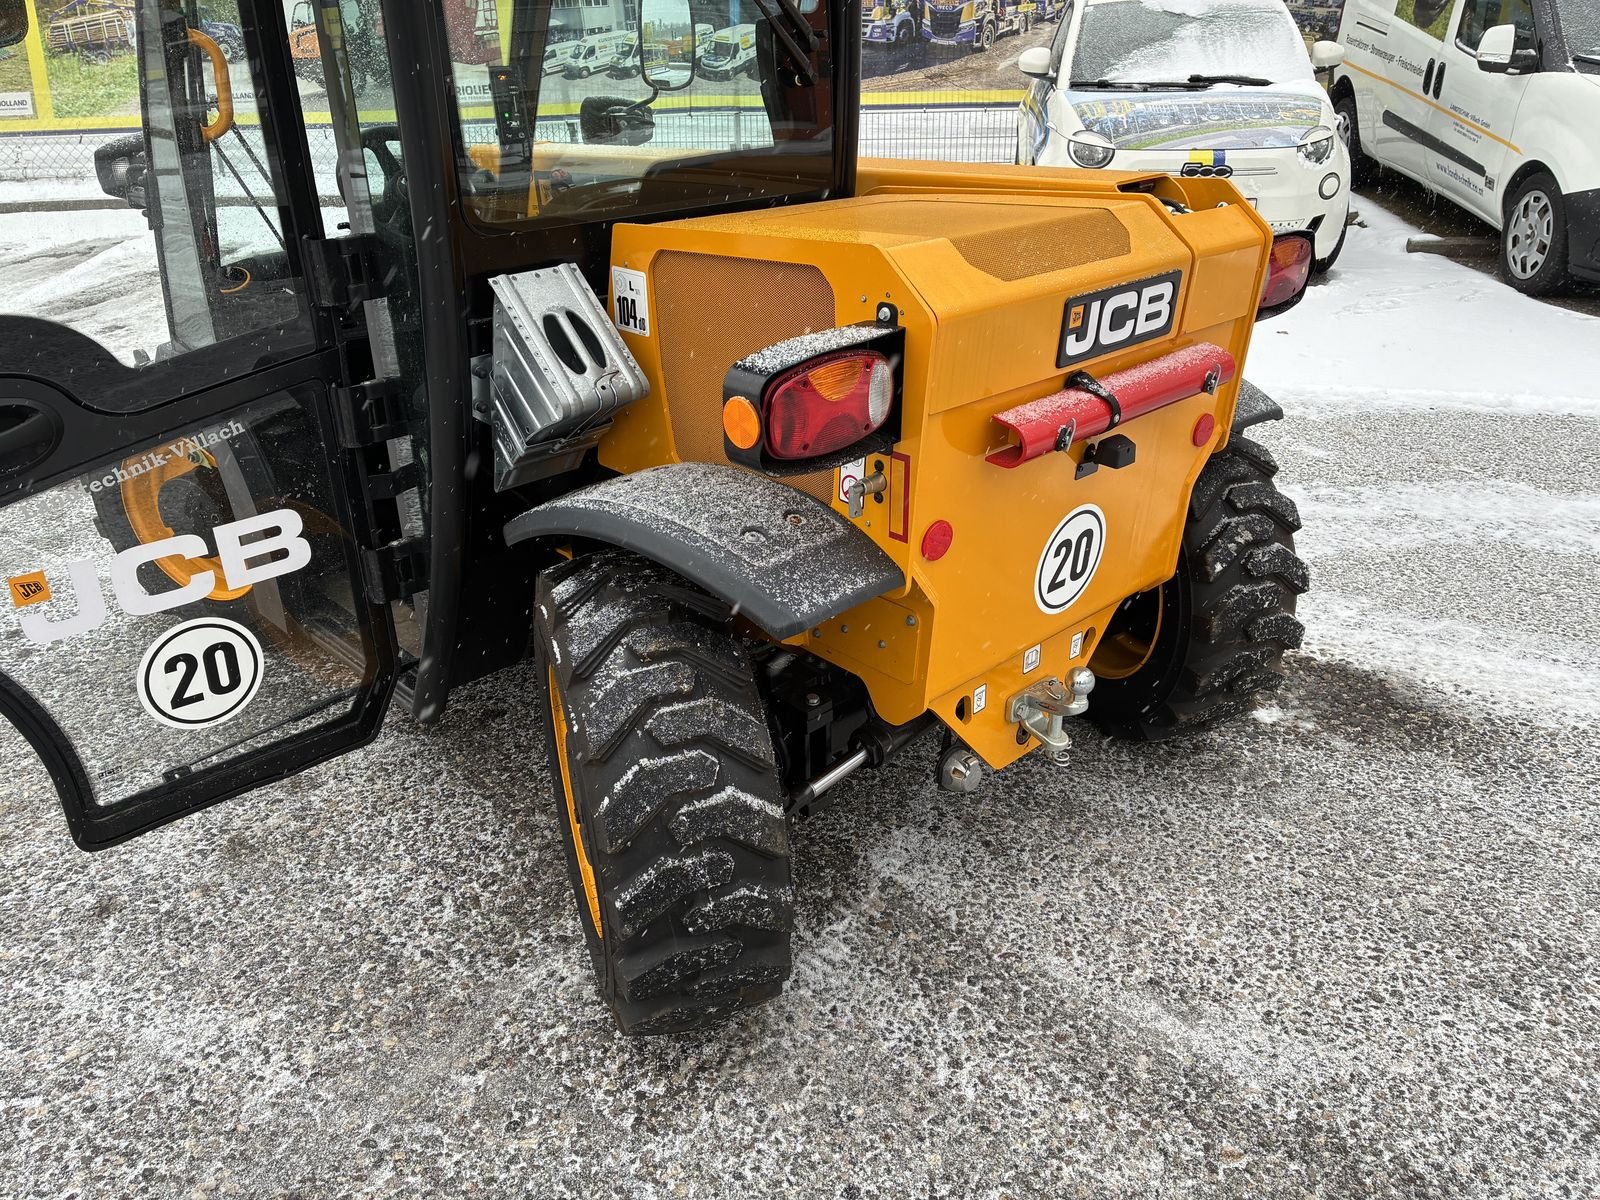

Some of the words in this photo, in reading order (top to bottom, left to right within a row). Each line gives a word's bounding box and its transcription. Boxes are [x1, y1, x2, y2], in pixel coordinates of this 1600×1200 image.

[0, 99, 28, 107] OLLAND
[616, 295, 638, 329] 104
[1065, 281, 1174, 356] JCB
[18, 509, 312, 643] JCB
[19, 582, 42, 598] JCB
[1046, 528, 1094, 595] 20
[164, 641, 242, 710] 20
